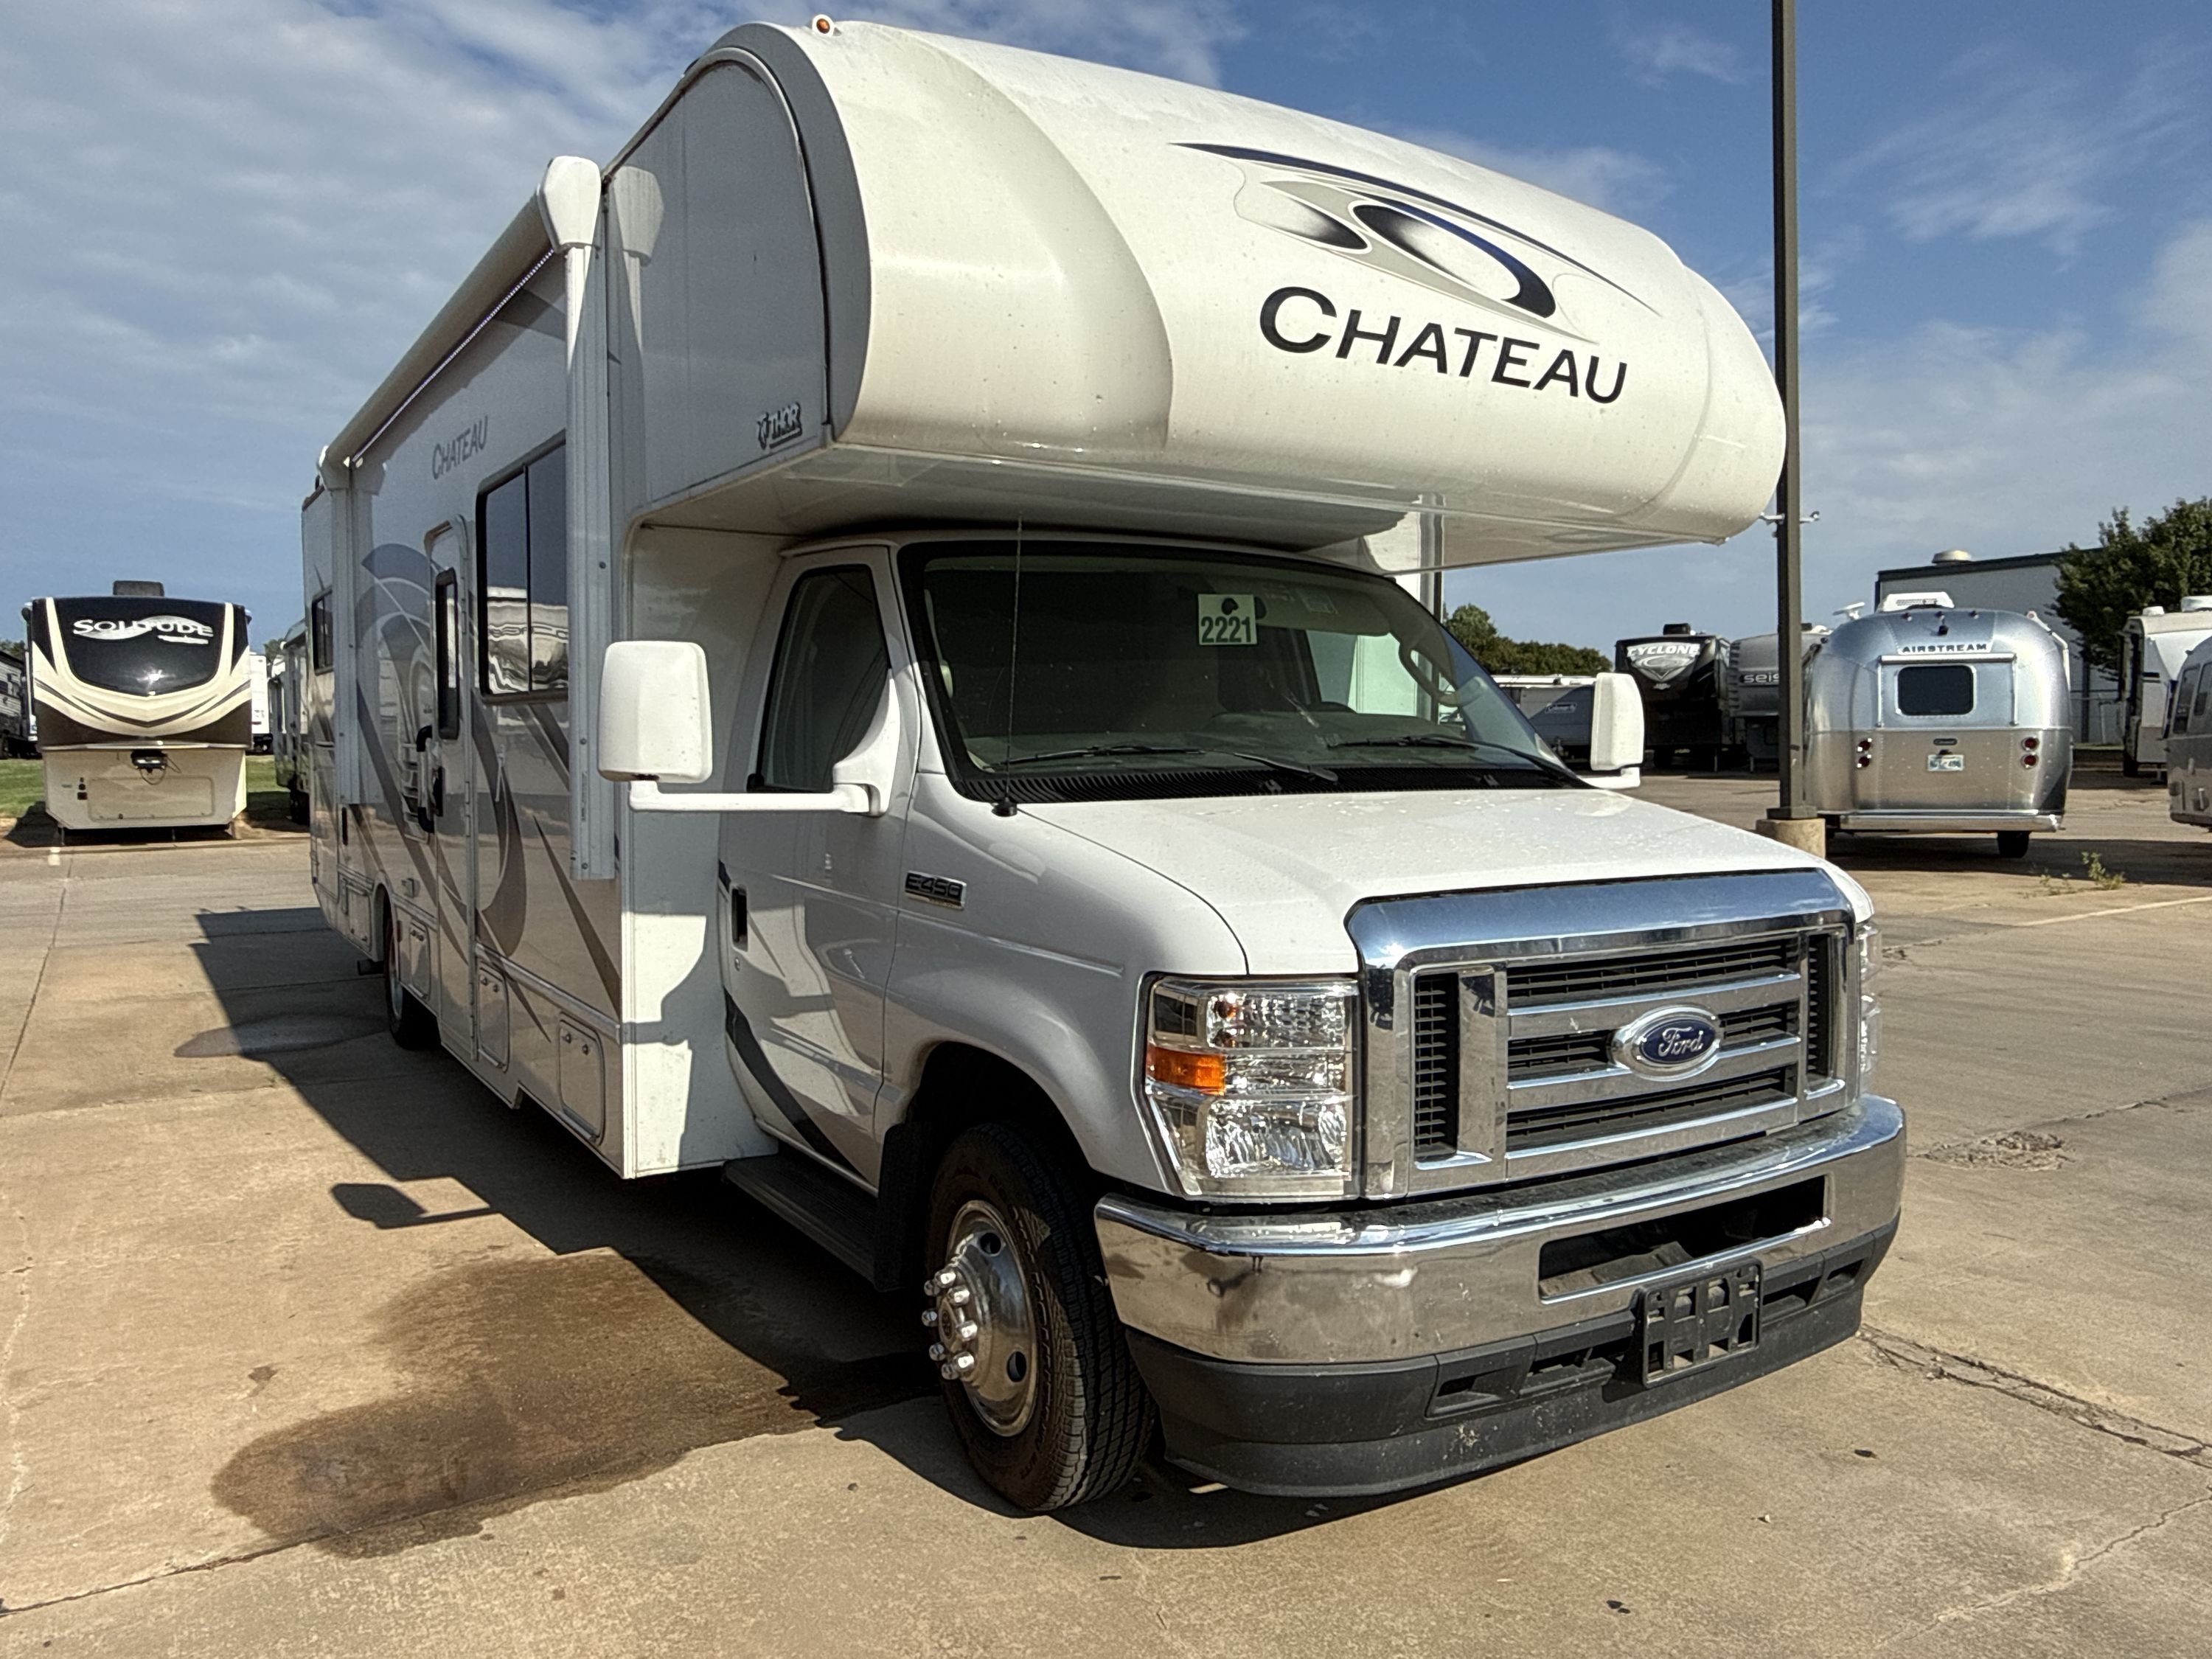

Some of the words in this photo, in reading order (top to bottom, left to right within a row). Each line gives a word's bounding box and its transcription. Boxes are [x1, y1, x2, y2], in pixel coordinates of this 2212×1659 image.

[1259, 286, 1628, 404] CHATEAU
[432, 414, 488, 480] CHATEAU
[1201, 616, 1251, 643] 2221
[1627, 643, 1701, 657] CYCLONE
[1902, 644, 1987, 653] AIRSTREAM
[1743, 672, 1779, 684] seis
[1658, 1026, 1704, 1057] Ford
